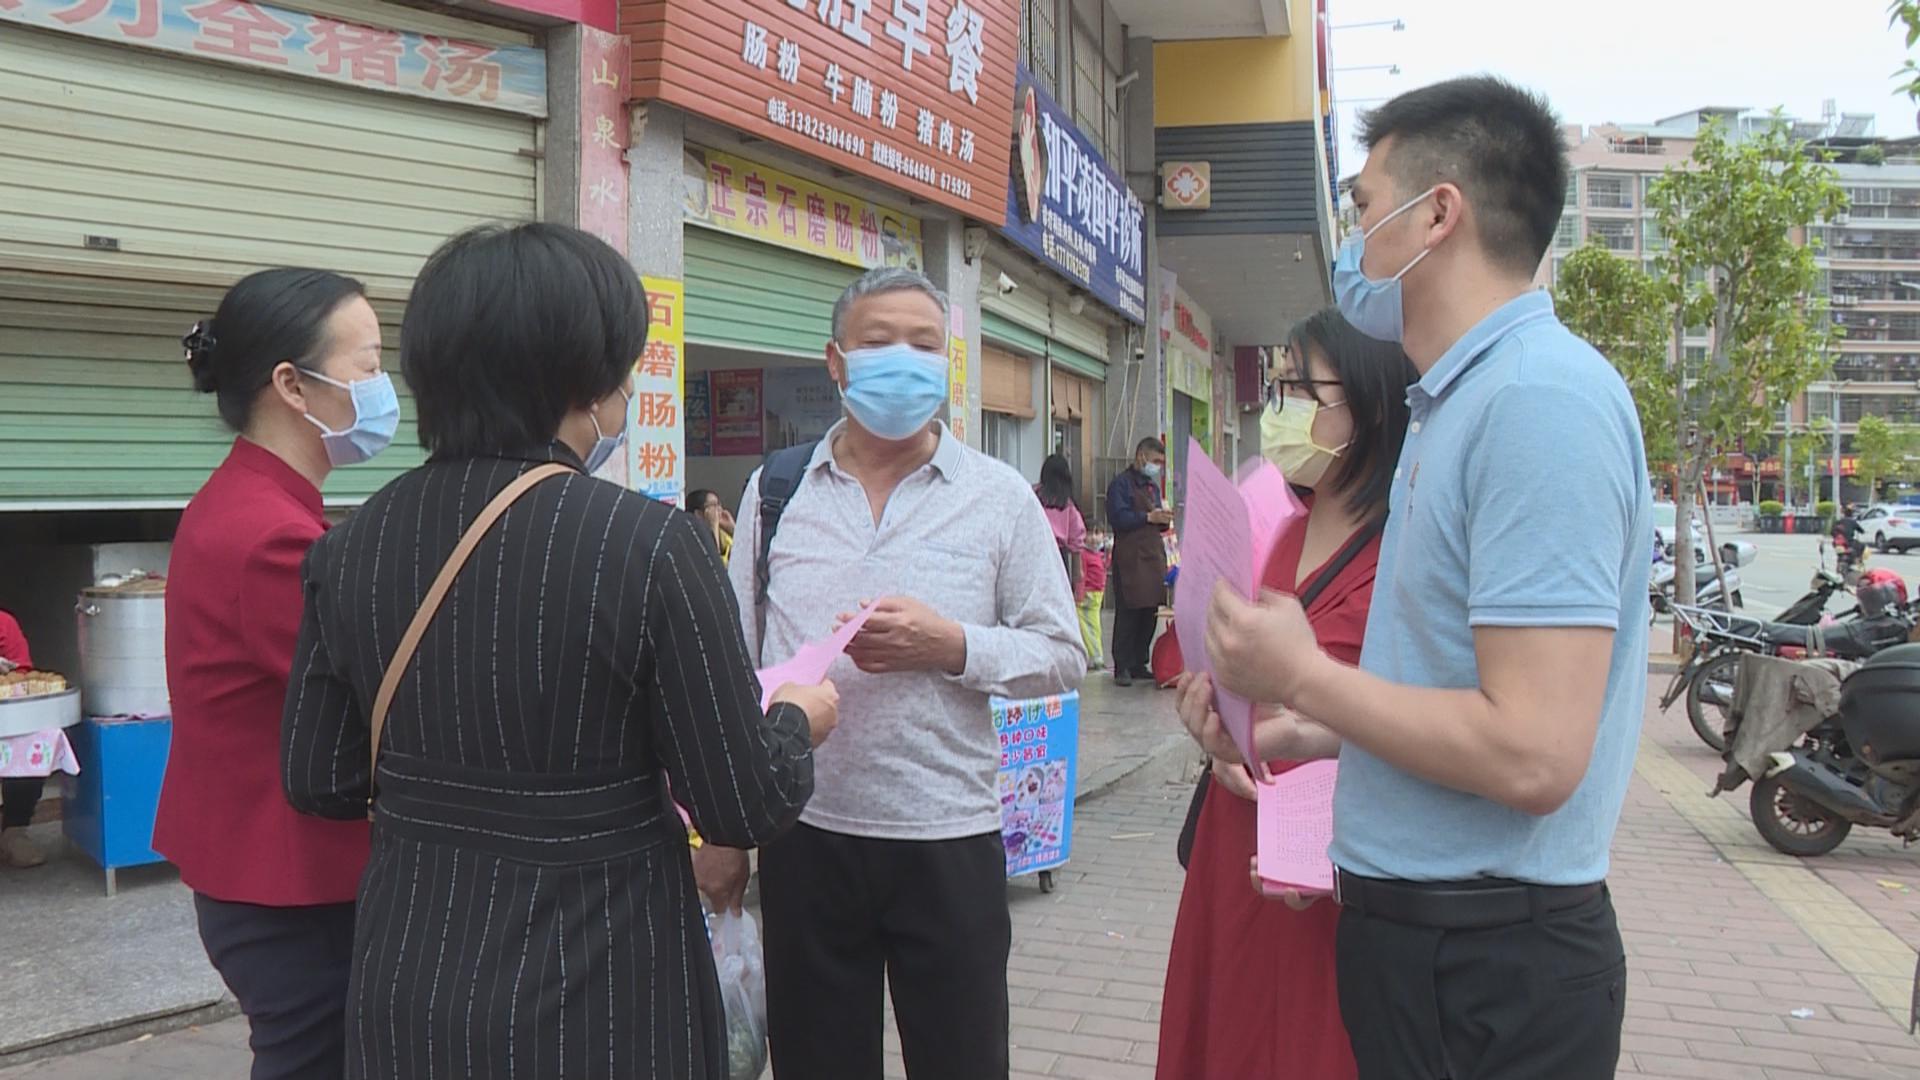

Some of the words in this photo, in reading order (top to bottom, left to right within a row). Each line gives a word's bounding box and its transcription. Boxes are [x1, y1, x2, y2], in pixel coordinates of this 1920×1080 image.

[743, 21, 800, 84] 肠粉
[825, 63, 898, 129] 牛腩粉
[917, 107, 975, 163] 猪肉汤
[711, 162, 879, 258] 正宗石磨肠粉
[637, 290, 677, 479] 石磨肠粉
